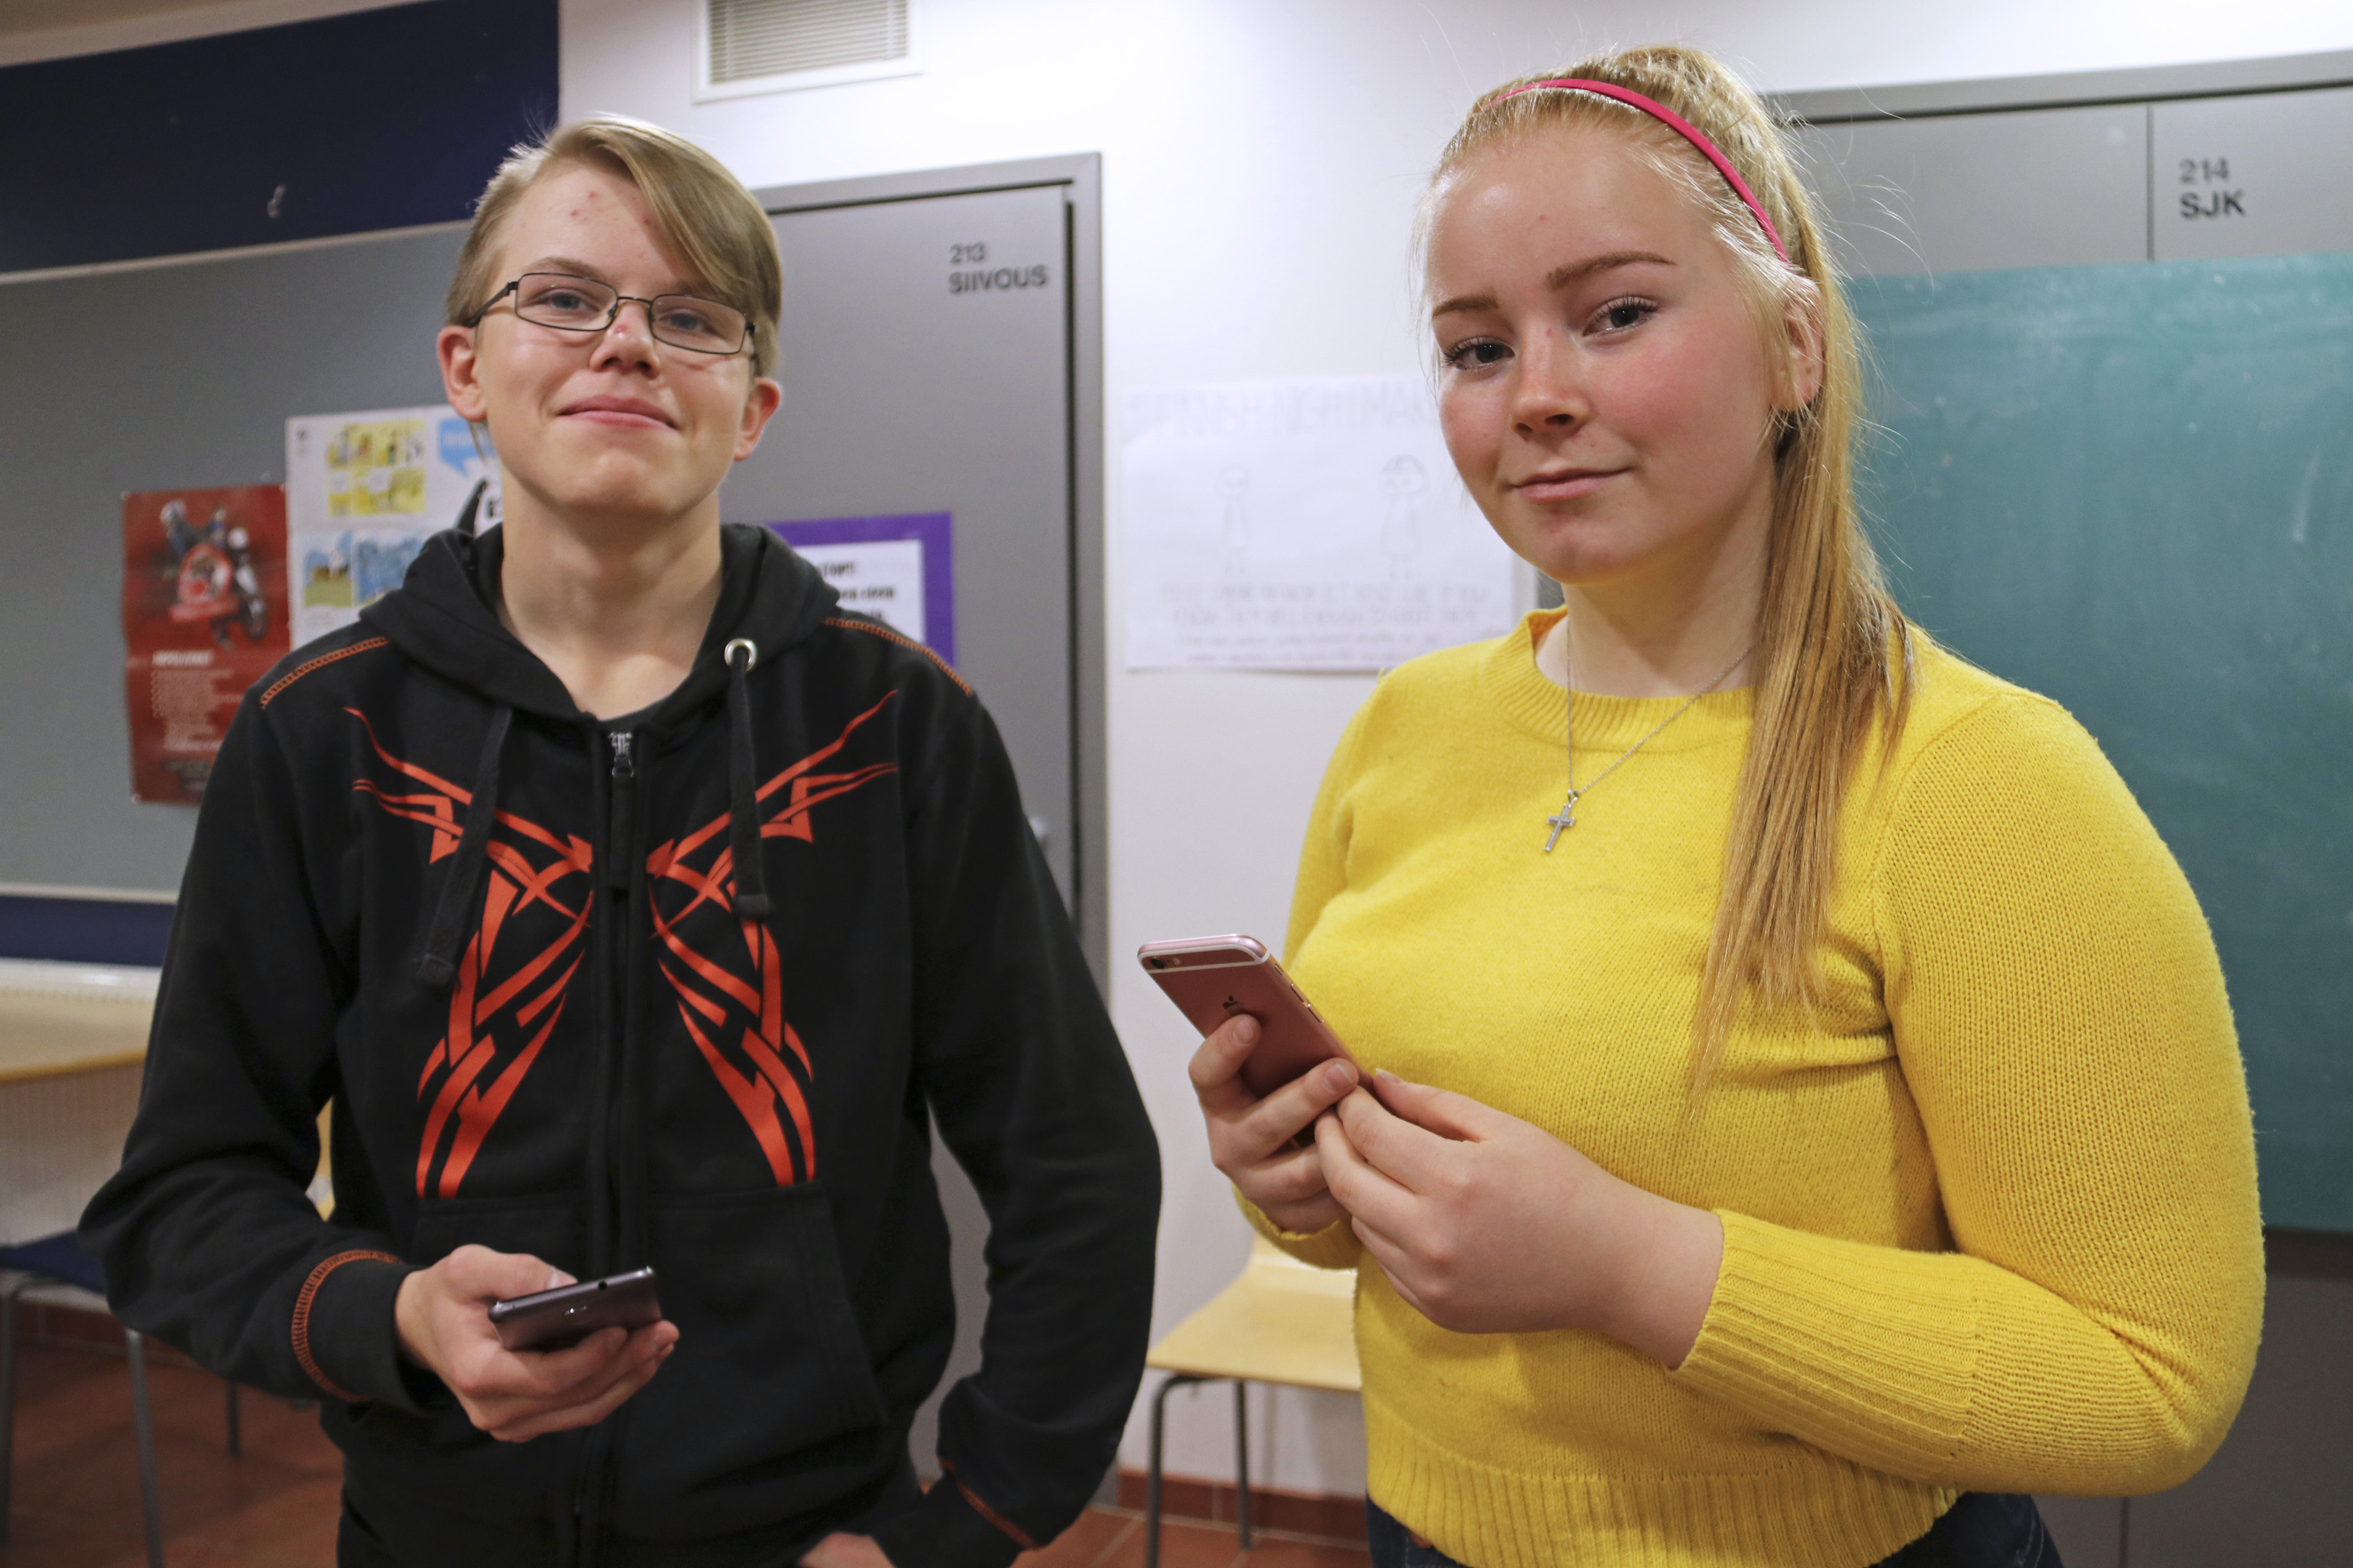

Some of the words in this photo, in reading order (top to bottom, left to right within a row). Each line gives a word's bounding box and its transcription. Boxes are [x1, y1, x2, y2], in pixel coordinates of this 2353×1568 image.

[2180, 157, 2229, 183] 214
[2180, 189, 2245, 219] SJK
[950, 242, 985, 264] 213
[948, 264, 1047, 294] SIIVOUS
